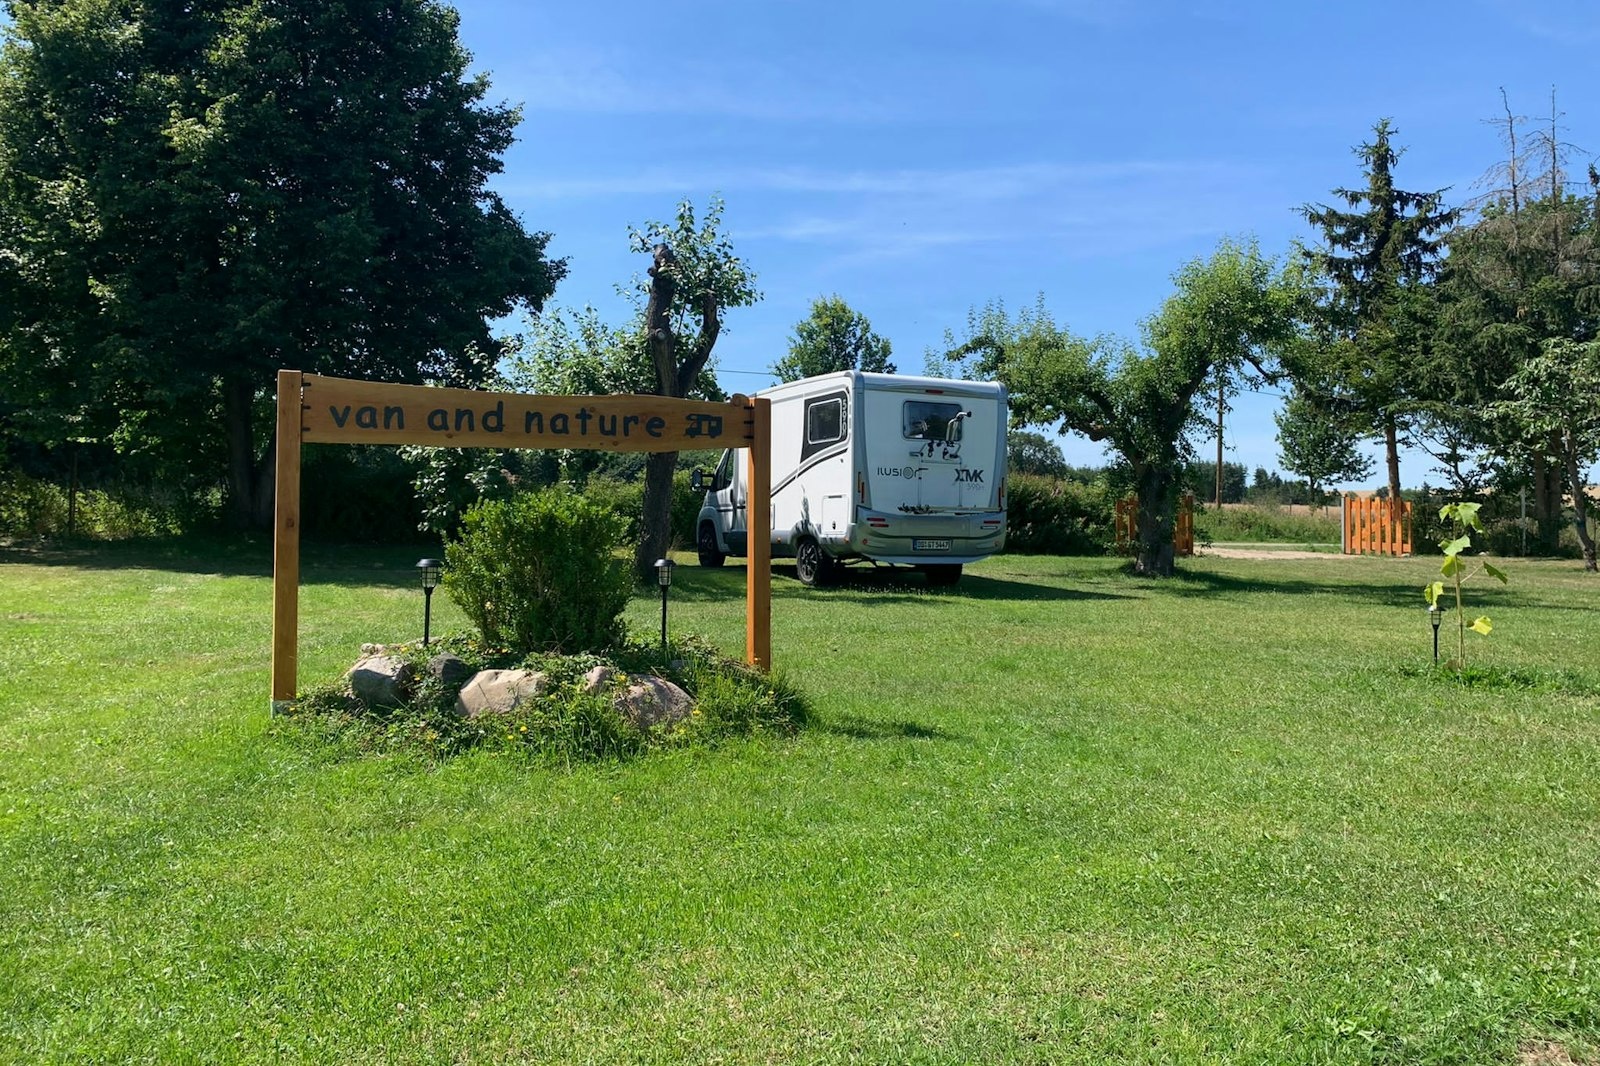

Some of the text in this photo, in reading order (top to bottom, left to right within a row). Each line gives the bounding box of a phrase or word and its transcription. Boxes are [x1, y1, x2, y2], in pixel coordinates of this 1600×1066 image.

[329, 400, 666, 438] van and nature
